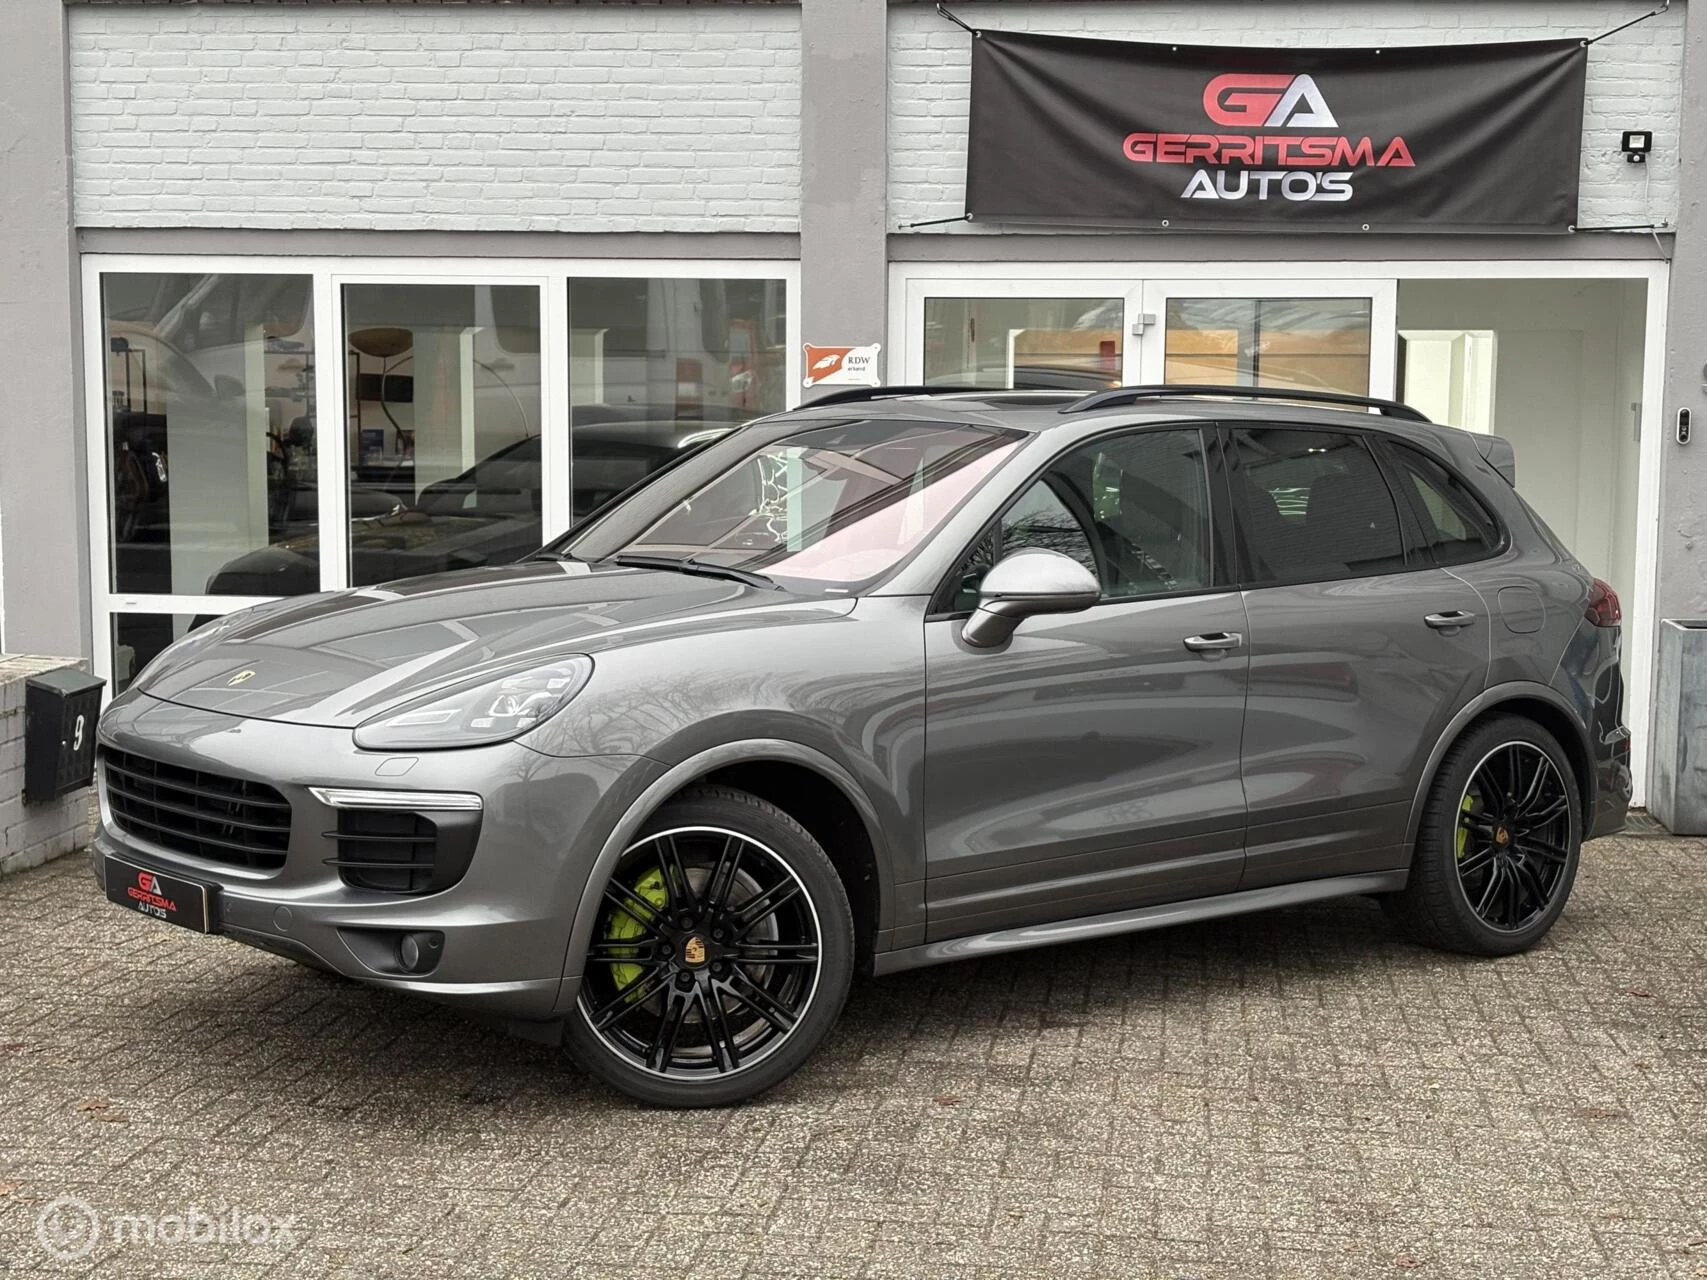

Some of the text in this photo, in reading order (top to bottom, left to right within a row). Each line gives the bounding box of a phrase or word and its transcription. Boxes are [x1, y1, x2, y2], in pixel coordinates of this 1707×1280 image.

[1203, 73, 1339, 128] GA
[1122, 132, 1416, 167] GERRITSMA
[1180, 168, 1354, 201] AUTO'S
[848, 356, 871, 364] RDW
[73, 715, 85, 751] 9
[127, 887, 177, 912] GERRITSMA
[138, 872, 162, 896] GA
